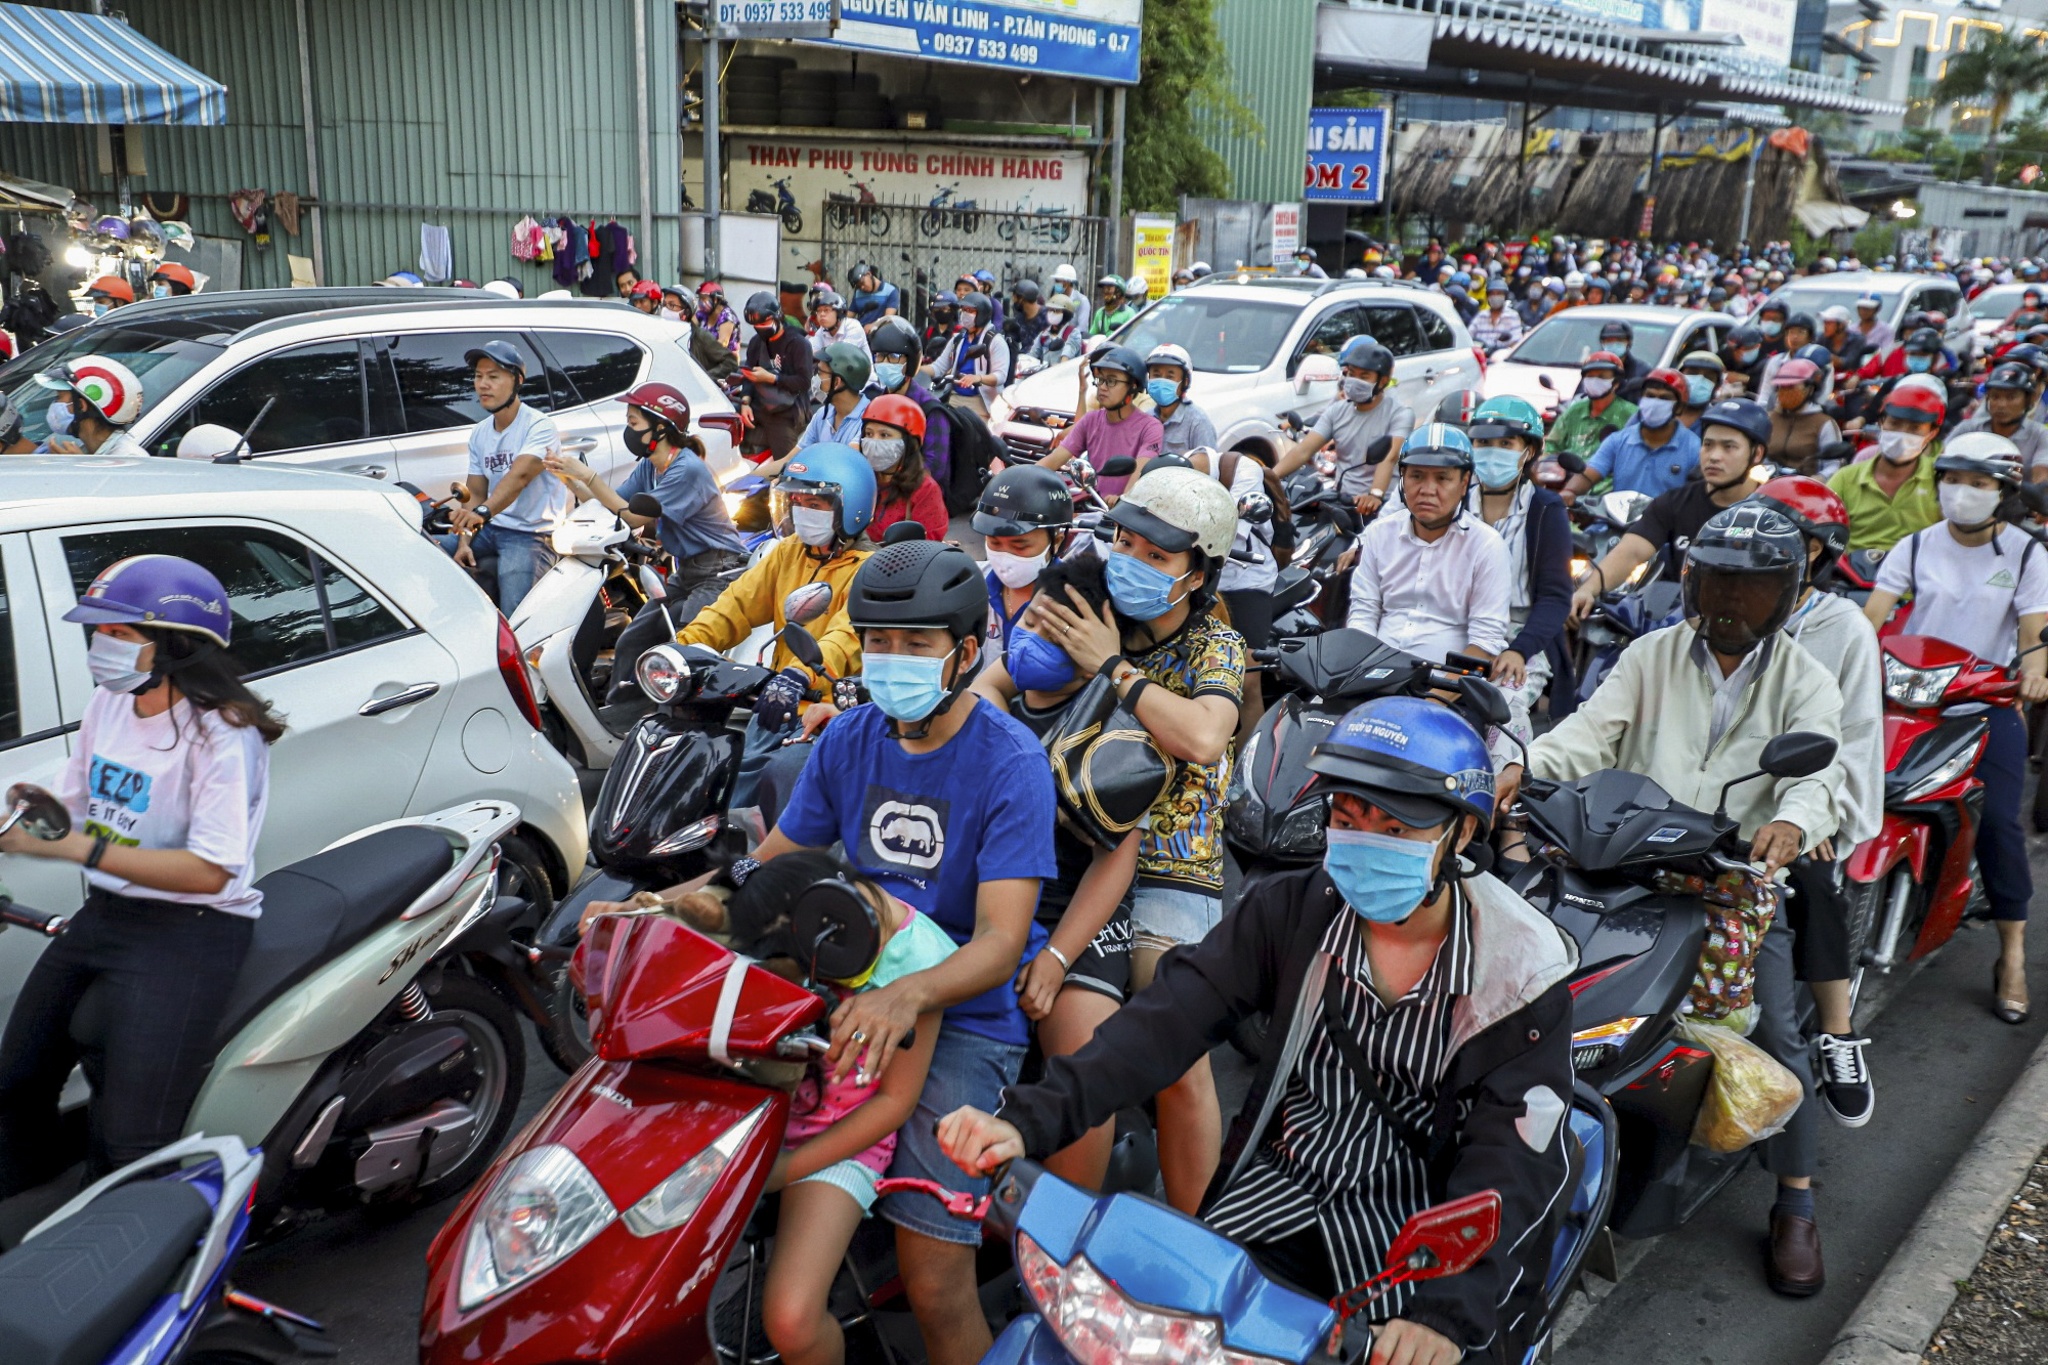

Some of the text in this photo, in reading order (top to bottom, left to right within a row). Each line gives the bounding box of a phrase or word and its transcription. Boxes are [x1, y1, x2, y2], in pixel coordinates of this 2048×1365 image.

[744, 2, 775, 22] 0937
[780, 3, 804, 21] 533
[808, 2, 831, 20] 499
[952, 7, 989, 31] LINH
[1003, 15, 1046, 39] P.TÂN
[1049, 22, 1097, 47] PHONG
[1108, 32, 1130, 51] Q.7
[934, 32, 974, 56] 0937
[977, 38, 1007, 60] 533
[1010, 43, 1039, 65] 499
[1327, 116, 1376, 151] SẢN
[748, 145, 801, 168] THAY
[808, 148, 854, 175] PHỤ
[860, 148, 919, 173] TÙNG
[926, 151, 995, 177] CHÍNH
[1350, 163, 1372, 191] 2
[1306, 717, 1336, 726] HONDA
[1563, 893, 1606, 909] HONDA
[590, 1083, 634, 1110] HONDA
